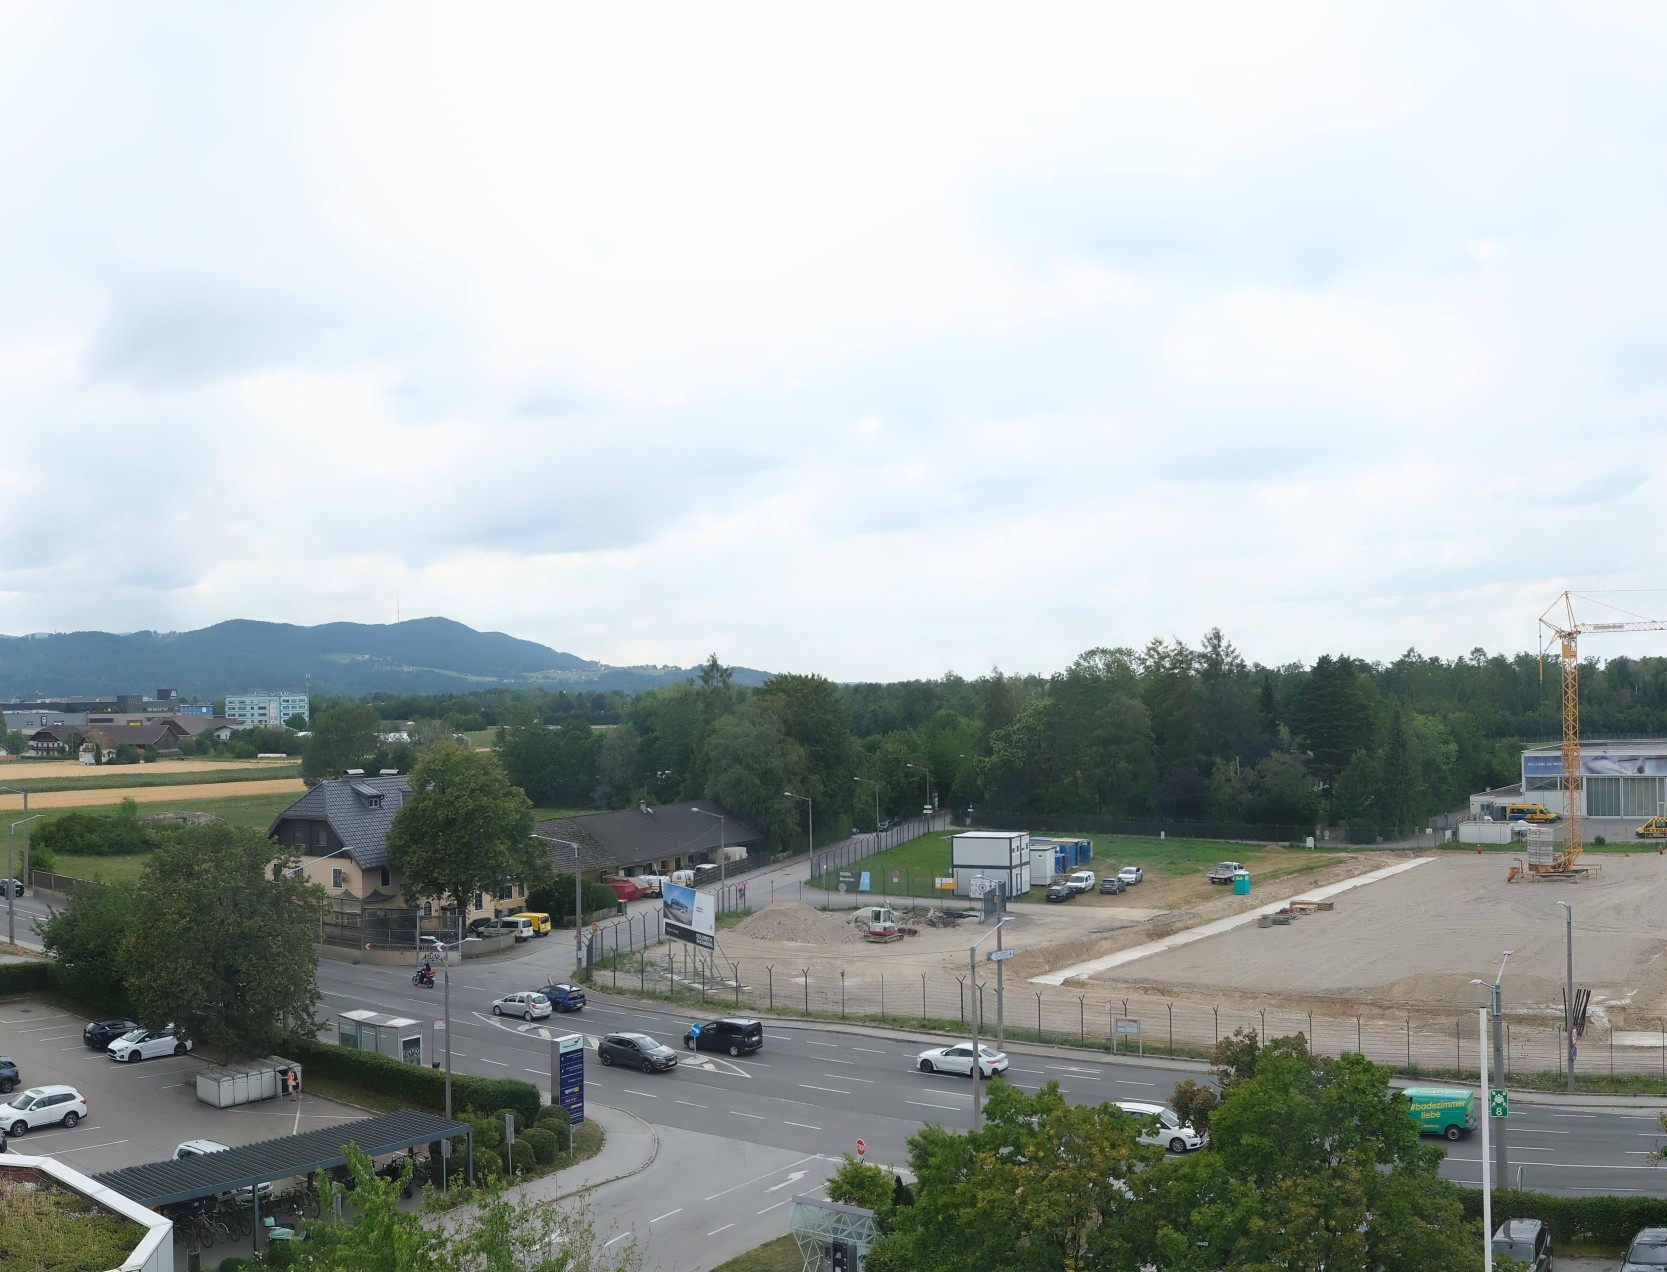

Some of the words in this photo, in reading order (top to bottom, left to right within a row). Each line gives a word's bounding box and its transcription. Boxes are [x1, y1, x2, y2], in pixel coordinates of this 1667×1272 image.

[1410, 1101, 1467, 1111] #badezimmer
[1420, 1111, 1441, 1119] liebe
[1495, 1107, 1503, 1116] 8
